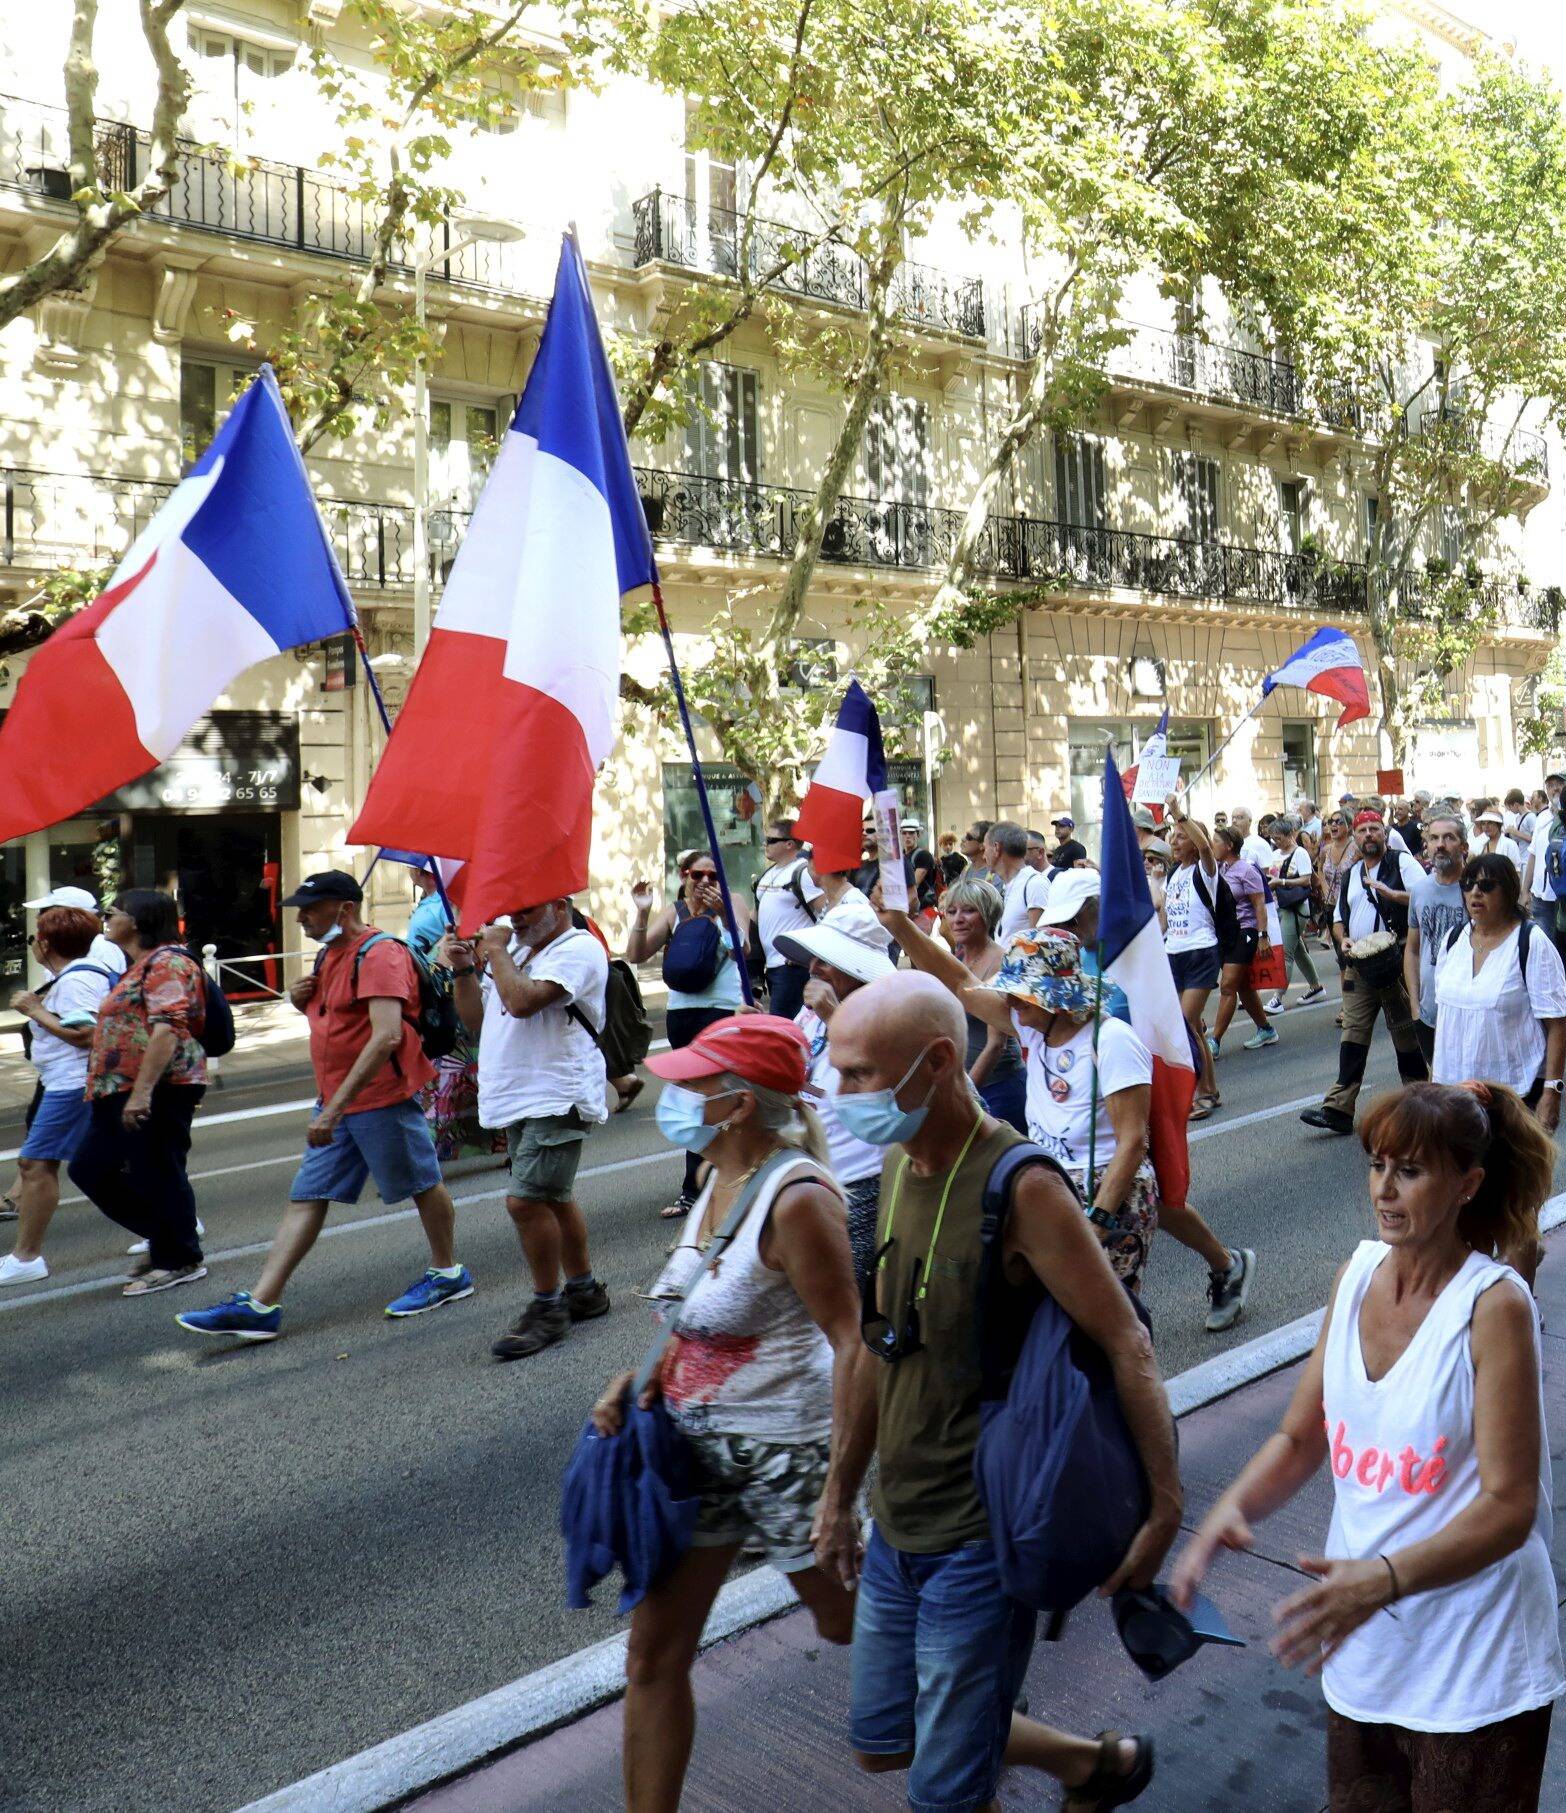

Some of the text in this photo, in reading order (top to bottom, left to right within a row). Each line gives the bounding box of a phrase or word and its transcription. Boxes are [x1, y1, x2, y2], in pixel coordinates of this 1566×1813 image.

[1147, 759, 1169, 770] NON
[236, 787, 255, 799] 65
[260, 786, 278, 799] 65
[1324, 1420, 1448, 1495] berté
